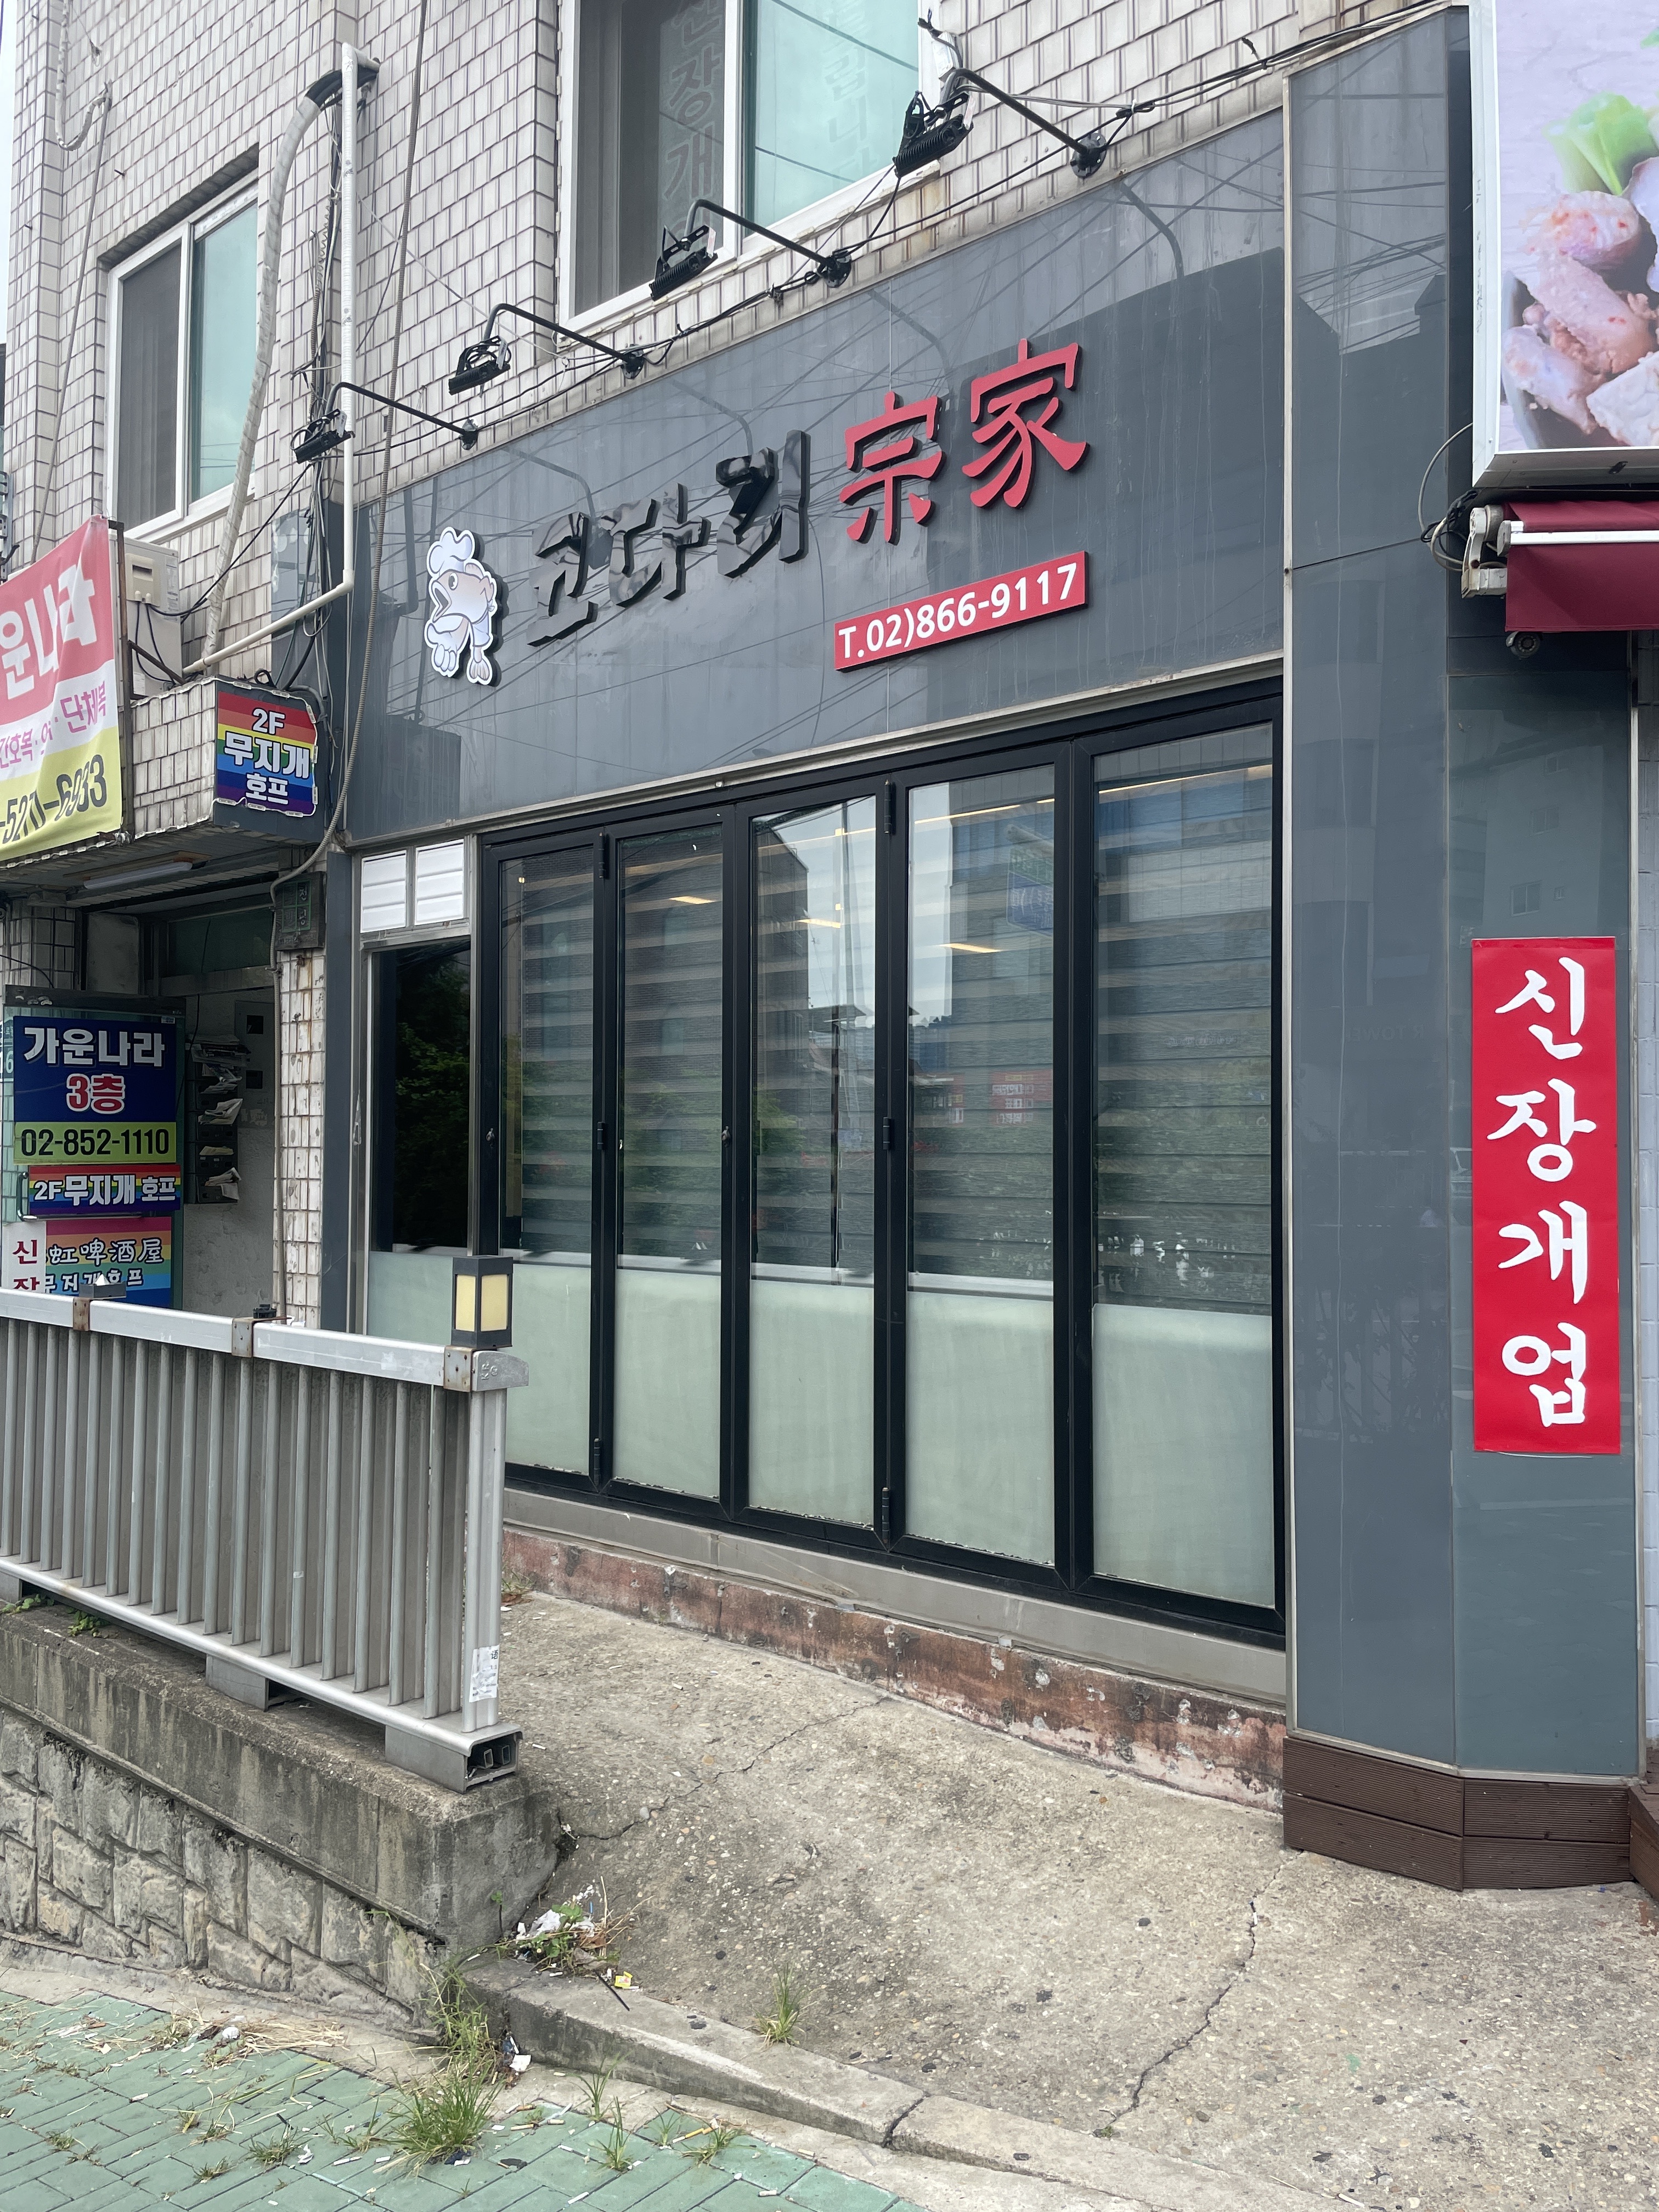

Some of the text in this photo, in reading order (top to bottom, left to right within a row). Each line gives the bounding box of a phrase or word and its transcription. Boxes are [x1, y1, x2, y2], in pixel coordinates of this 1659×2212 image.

[839, 339, 1088, 545] 宗家
[838, 562, 1077, 658] T.02)866-9117
[252, 708, 285, 735] 2F
[224, 731, 311, 779] 무지개
[246, 773, 289, 805] 호프
[24, 1027, 165, 1067] 가운나라
[66, 1073, 126, 1114] 3층
[21, 1128, 169, 1156] 02-852-1110
[142, 1177, 176, 1201] 호프
[1487, 957, 1596, 1427] 신장개업
[46, 1238, 163, 1266] 虹啤酒屋
